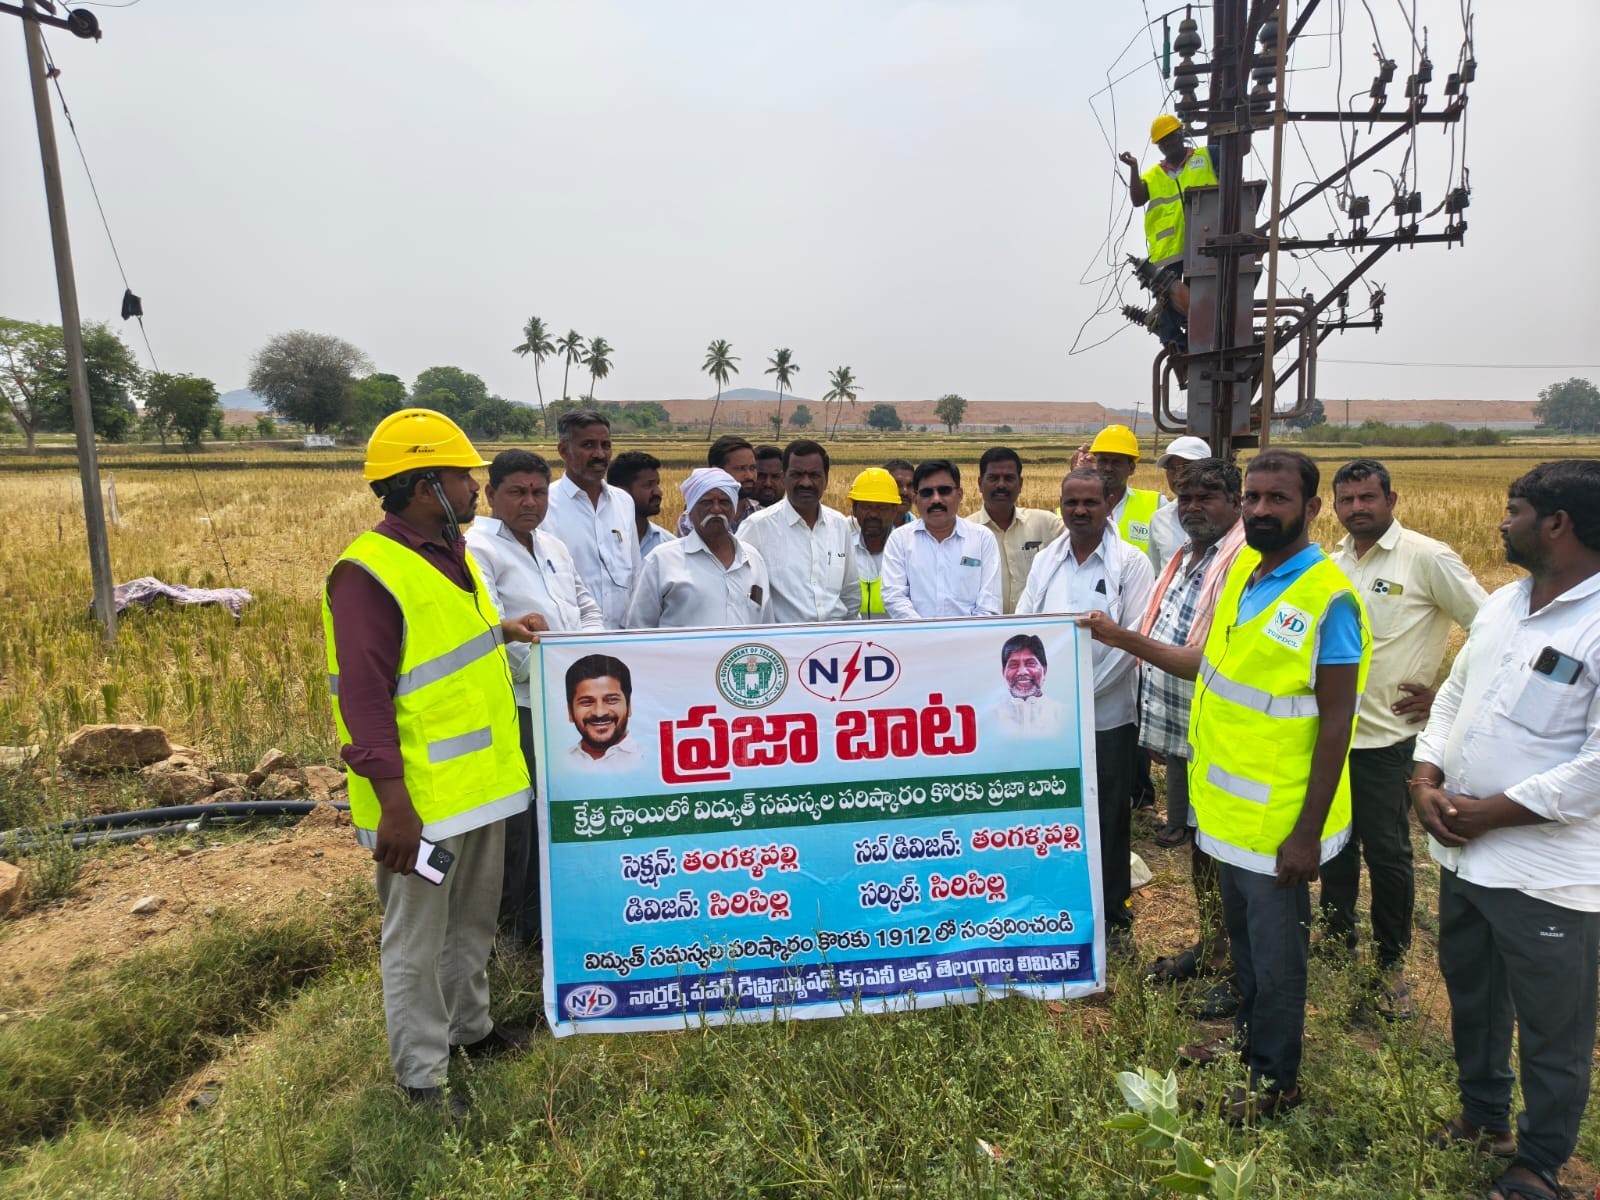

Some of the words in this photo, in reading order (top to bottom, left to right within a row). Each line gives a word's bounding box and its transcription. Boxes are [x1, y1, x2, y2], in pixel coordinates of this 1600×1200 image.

[660, 705, 818, 784] ప్రజా
[835, 693, 977, 761] బాట
[573, 802, 606, 837] క్షేత్ర
[694, 792, 757, 827] విద్యుత్
[760, 791, 836, 822] సమస్యల
[839, 786, 926, 813] పరిష్కారం
[930, 782, 984, 803] కొరకు
[987, 779, 1025, 806] ప్రజా
[1028, 774, 1066, 797] బాట
[856, 836, 889, 863] సబ్
[709, 889, 790, 917] సిరిసిల్ల
[930, 873, 1006, 900] సిరిసిల్ల
[585, 946, 645, 975] విద్యుత్
[650, 943, 724, 967] సమస్యల
[729, 936, 813, 961] పరిష్కారం
[818, 930, 870, 950] కొరకు
[876, 930, 932, 946] 1912
[935, 920, 957, 941] లో
[961, 912, 1073, 940] సంప్రదించండి
[839, 965, 896, 987] కంపెనీ
[900, 962, 932, 982] ఆఫ్
[936, 957, 1014, 977] తెలంగాణ
[1018, 951, 1080, 971] లిమిటెడ్
